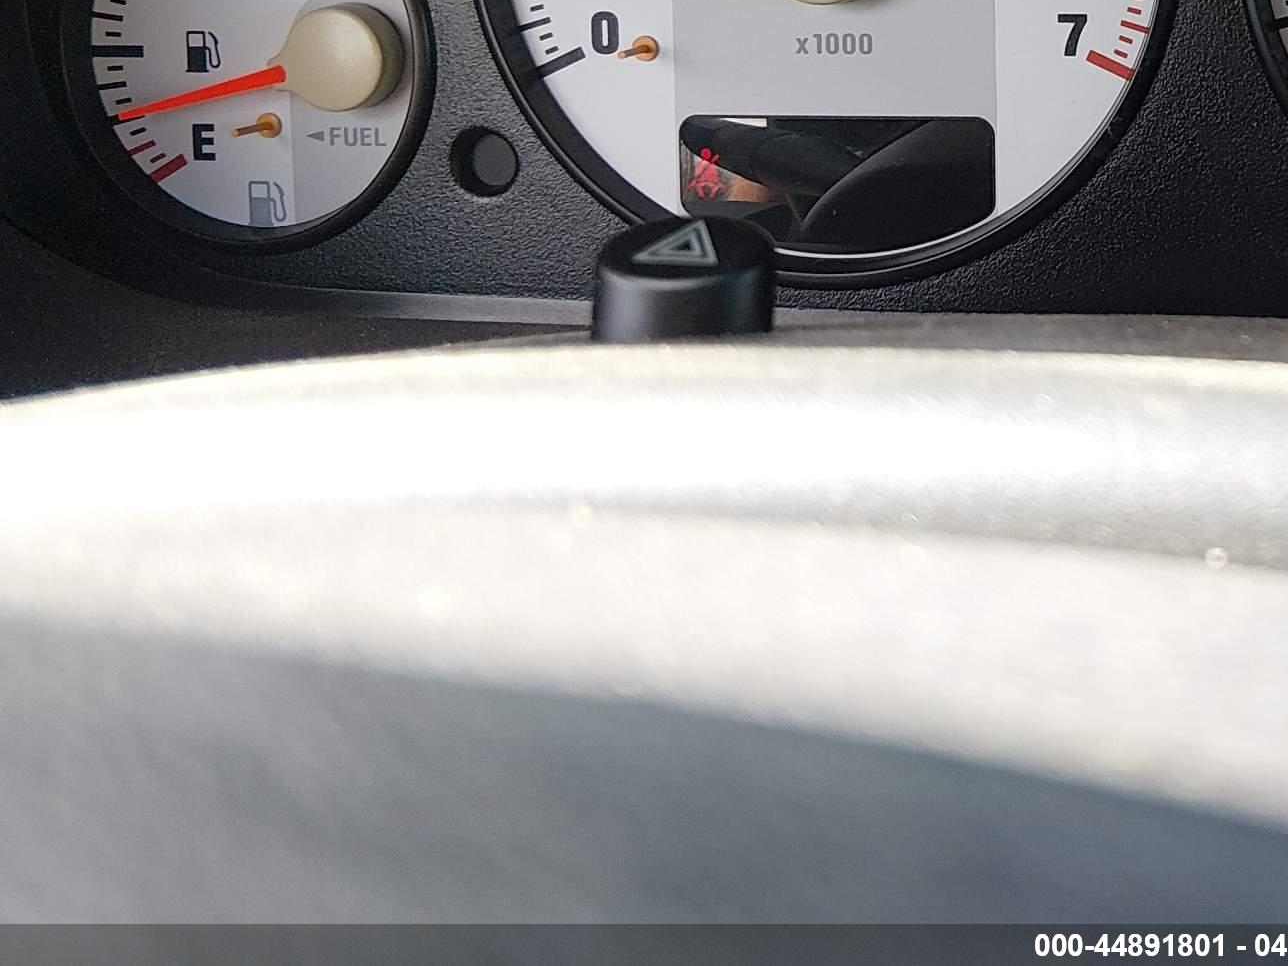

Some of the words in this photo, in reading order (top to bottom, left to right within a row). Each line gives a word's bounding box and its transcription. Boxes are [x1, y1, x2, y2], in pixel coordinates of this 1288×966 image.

[591, 11, 619, 54] 0
[796, 33, 872, 54] x1000
[1058, 14, 1087, 56] 7
[192, 124, 216, 161] E
[330, 127, 386, 146] FUEL
